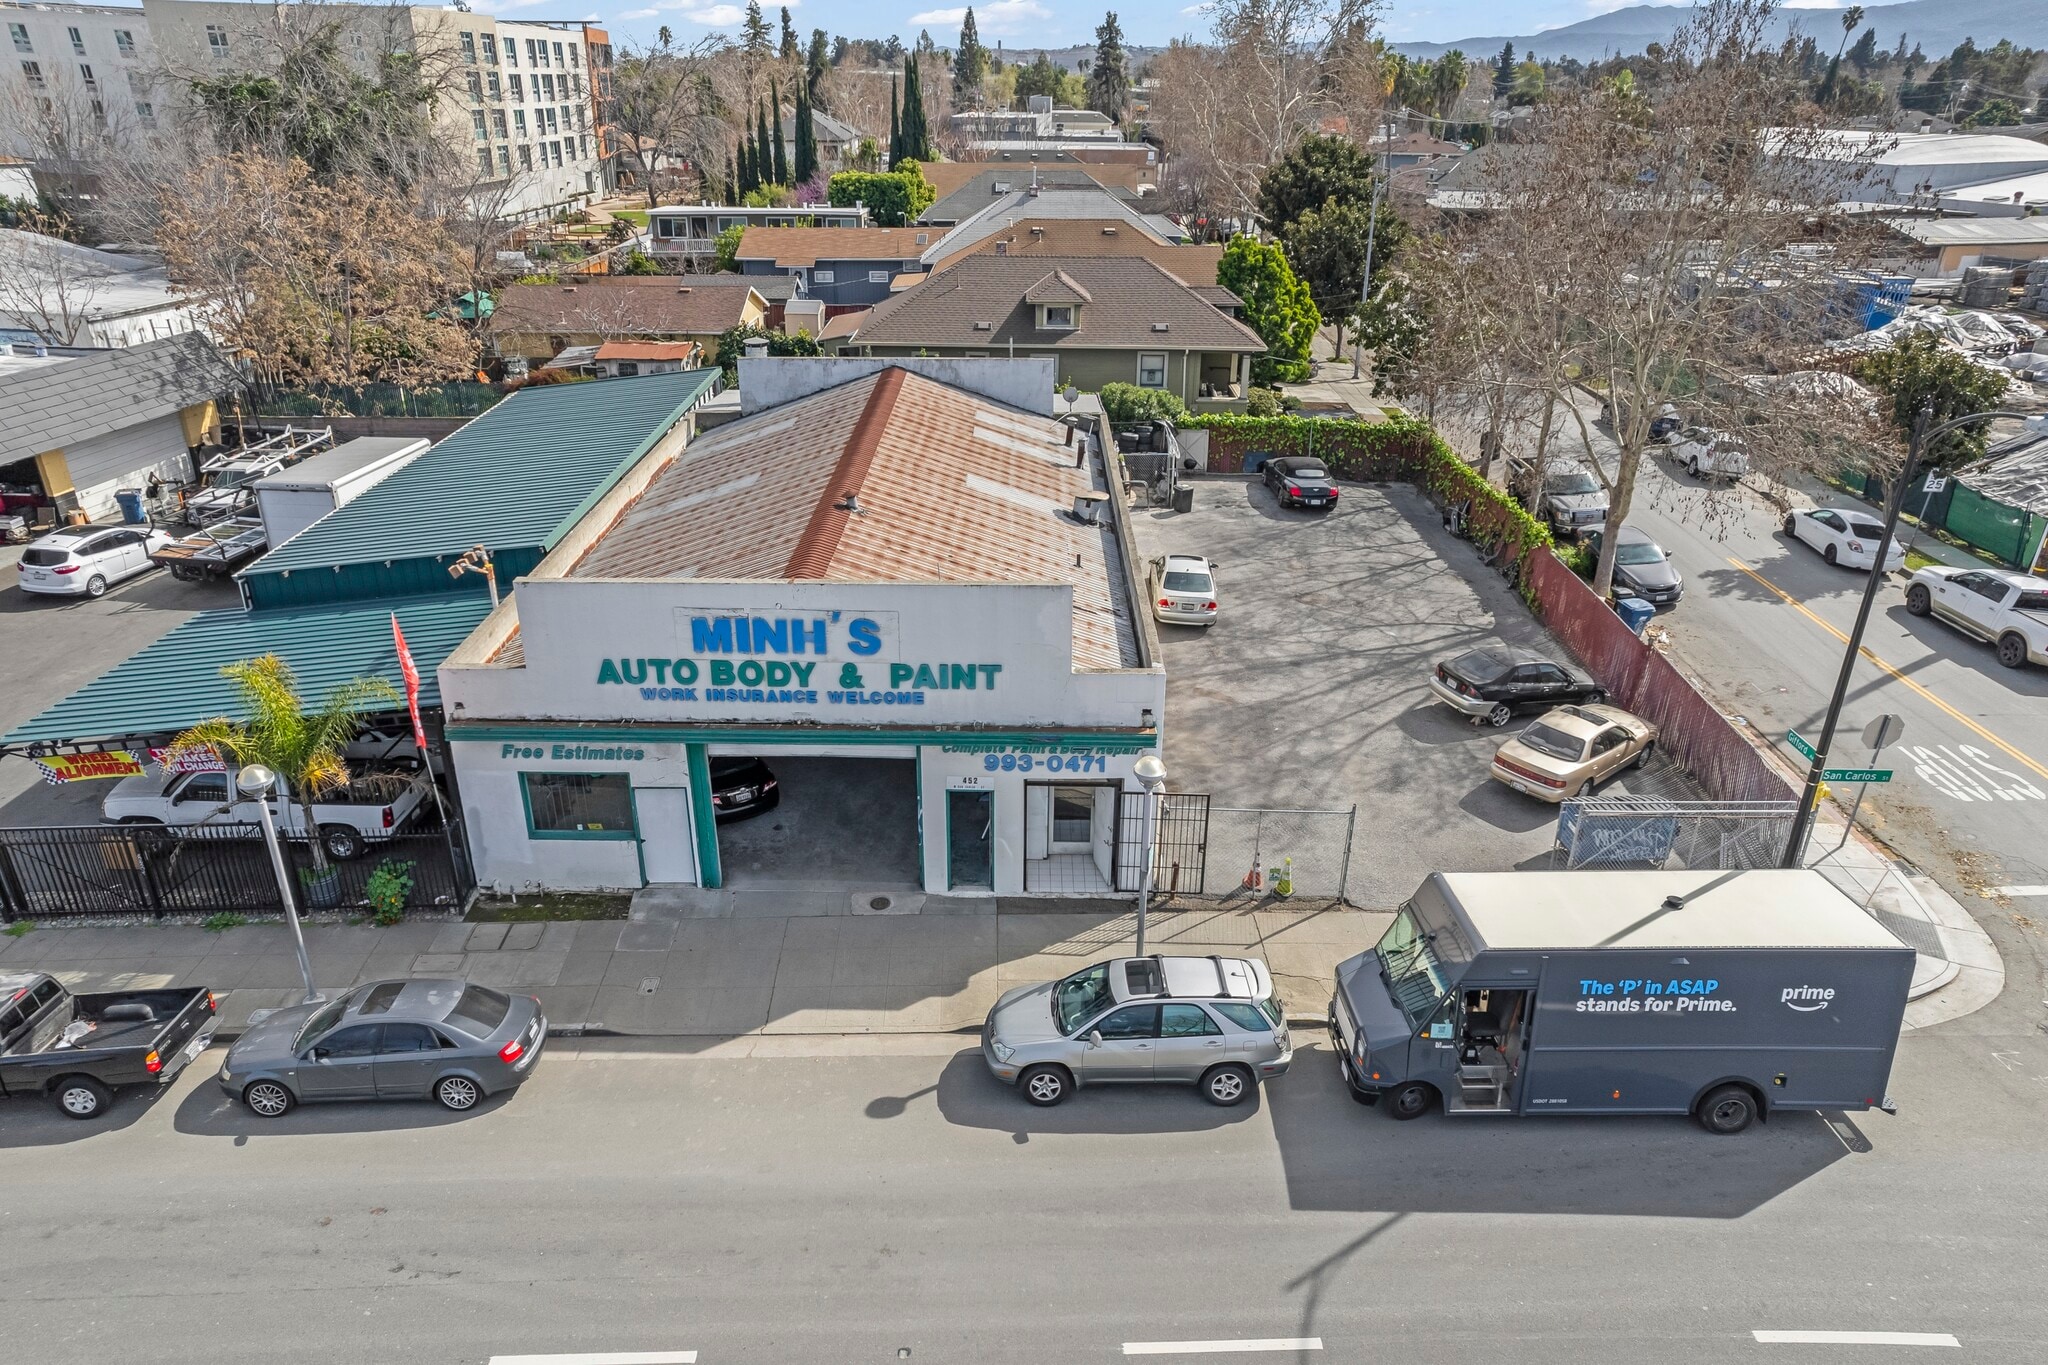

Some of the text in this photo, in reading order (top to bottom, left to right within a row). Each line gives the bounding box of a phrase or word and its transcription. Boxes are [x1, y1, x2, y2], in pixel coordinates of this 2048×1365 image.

[1926, 480, 1943, 489] 25
[691, 611, 881, 656] MINH'S
[597, 658, 1002, 690] AUTO BODY & PAINT
[640, 688, 925, 705] WORK INSURANCE WELCOME
[1788, 732, 1808, 754] Gifford
[63, 752, 119, 766] WHEEL
[501, 744, 645, 760] Free Estimates
[56, 761, 142, 781] ALIGNMENT
[185, 761, 224, 771] CHANGE
[984, 754, 1105, 772] 993-0471
[1823, 771, 1842, 781] San
[1845, 771, 1877, 781] Carlos
[1580, 980, 1614, 995] The
[1645, 980, 1662, 995] in
[1665, 980, 1718, 995] ASAP
[1781, 985, 1835, 1002] prime
[1576, 997, 1737, 1012] stands for Prime.
